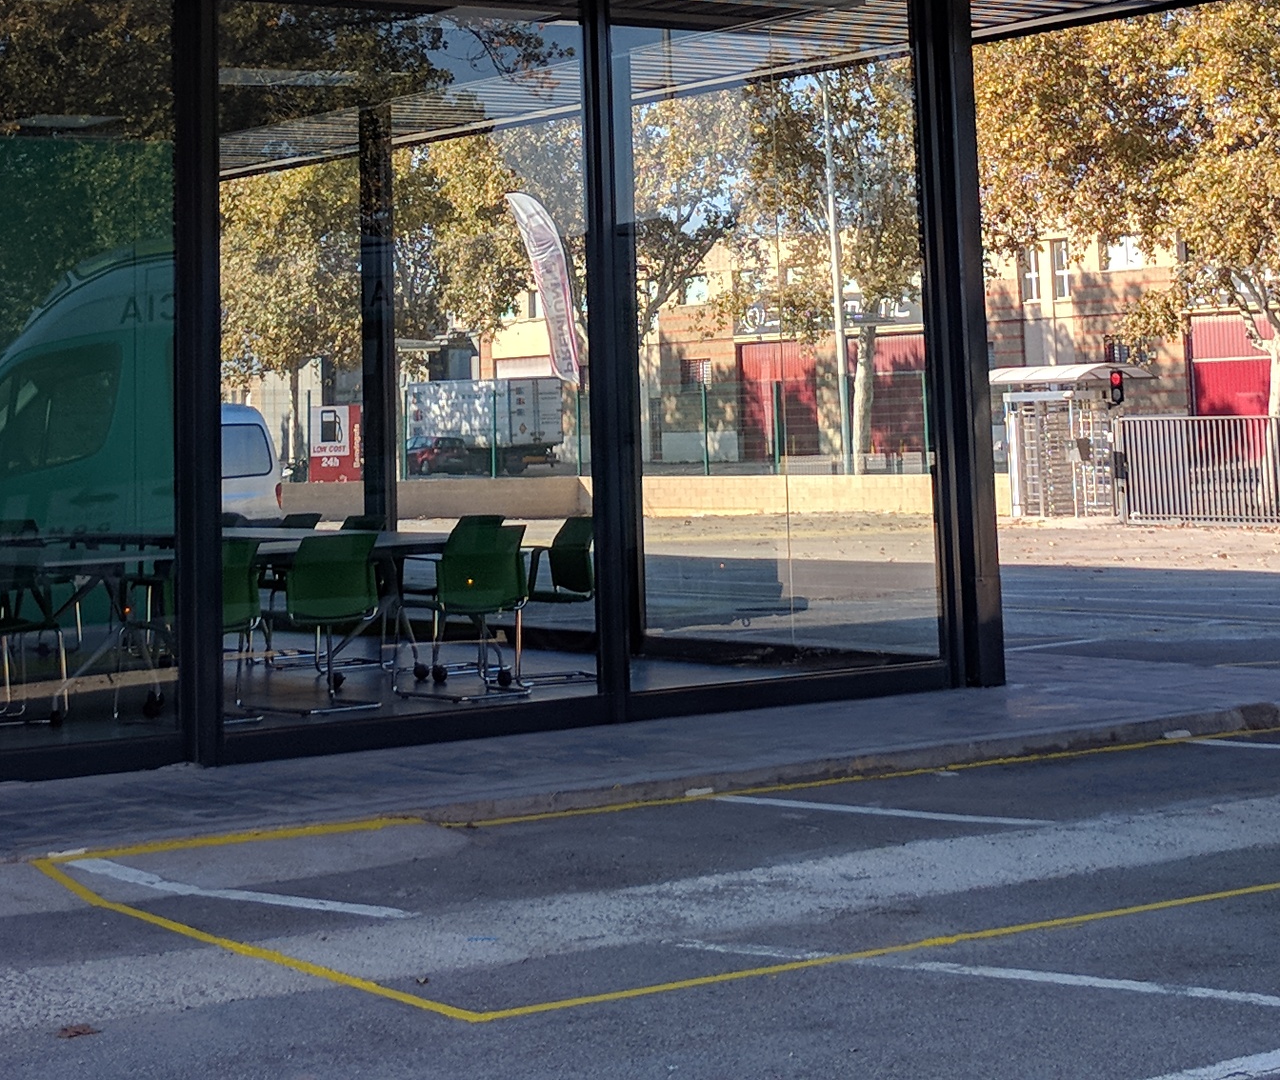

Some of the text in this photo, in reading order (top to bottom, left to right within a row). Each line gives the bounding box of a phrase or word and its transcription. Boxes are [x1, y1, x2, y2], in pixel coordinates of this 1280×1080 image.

[312, 445, 346, 453] LOW COST
[321, 456, 340, 467] 24h
